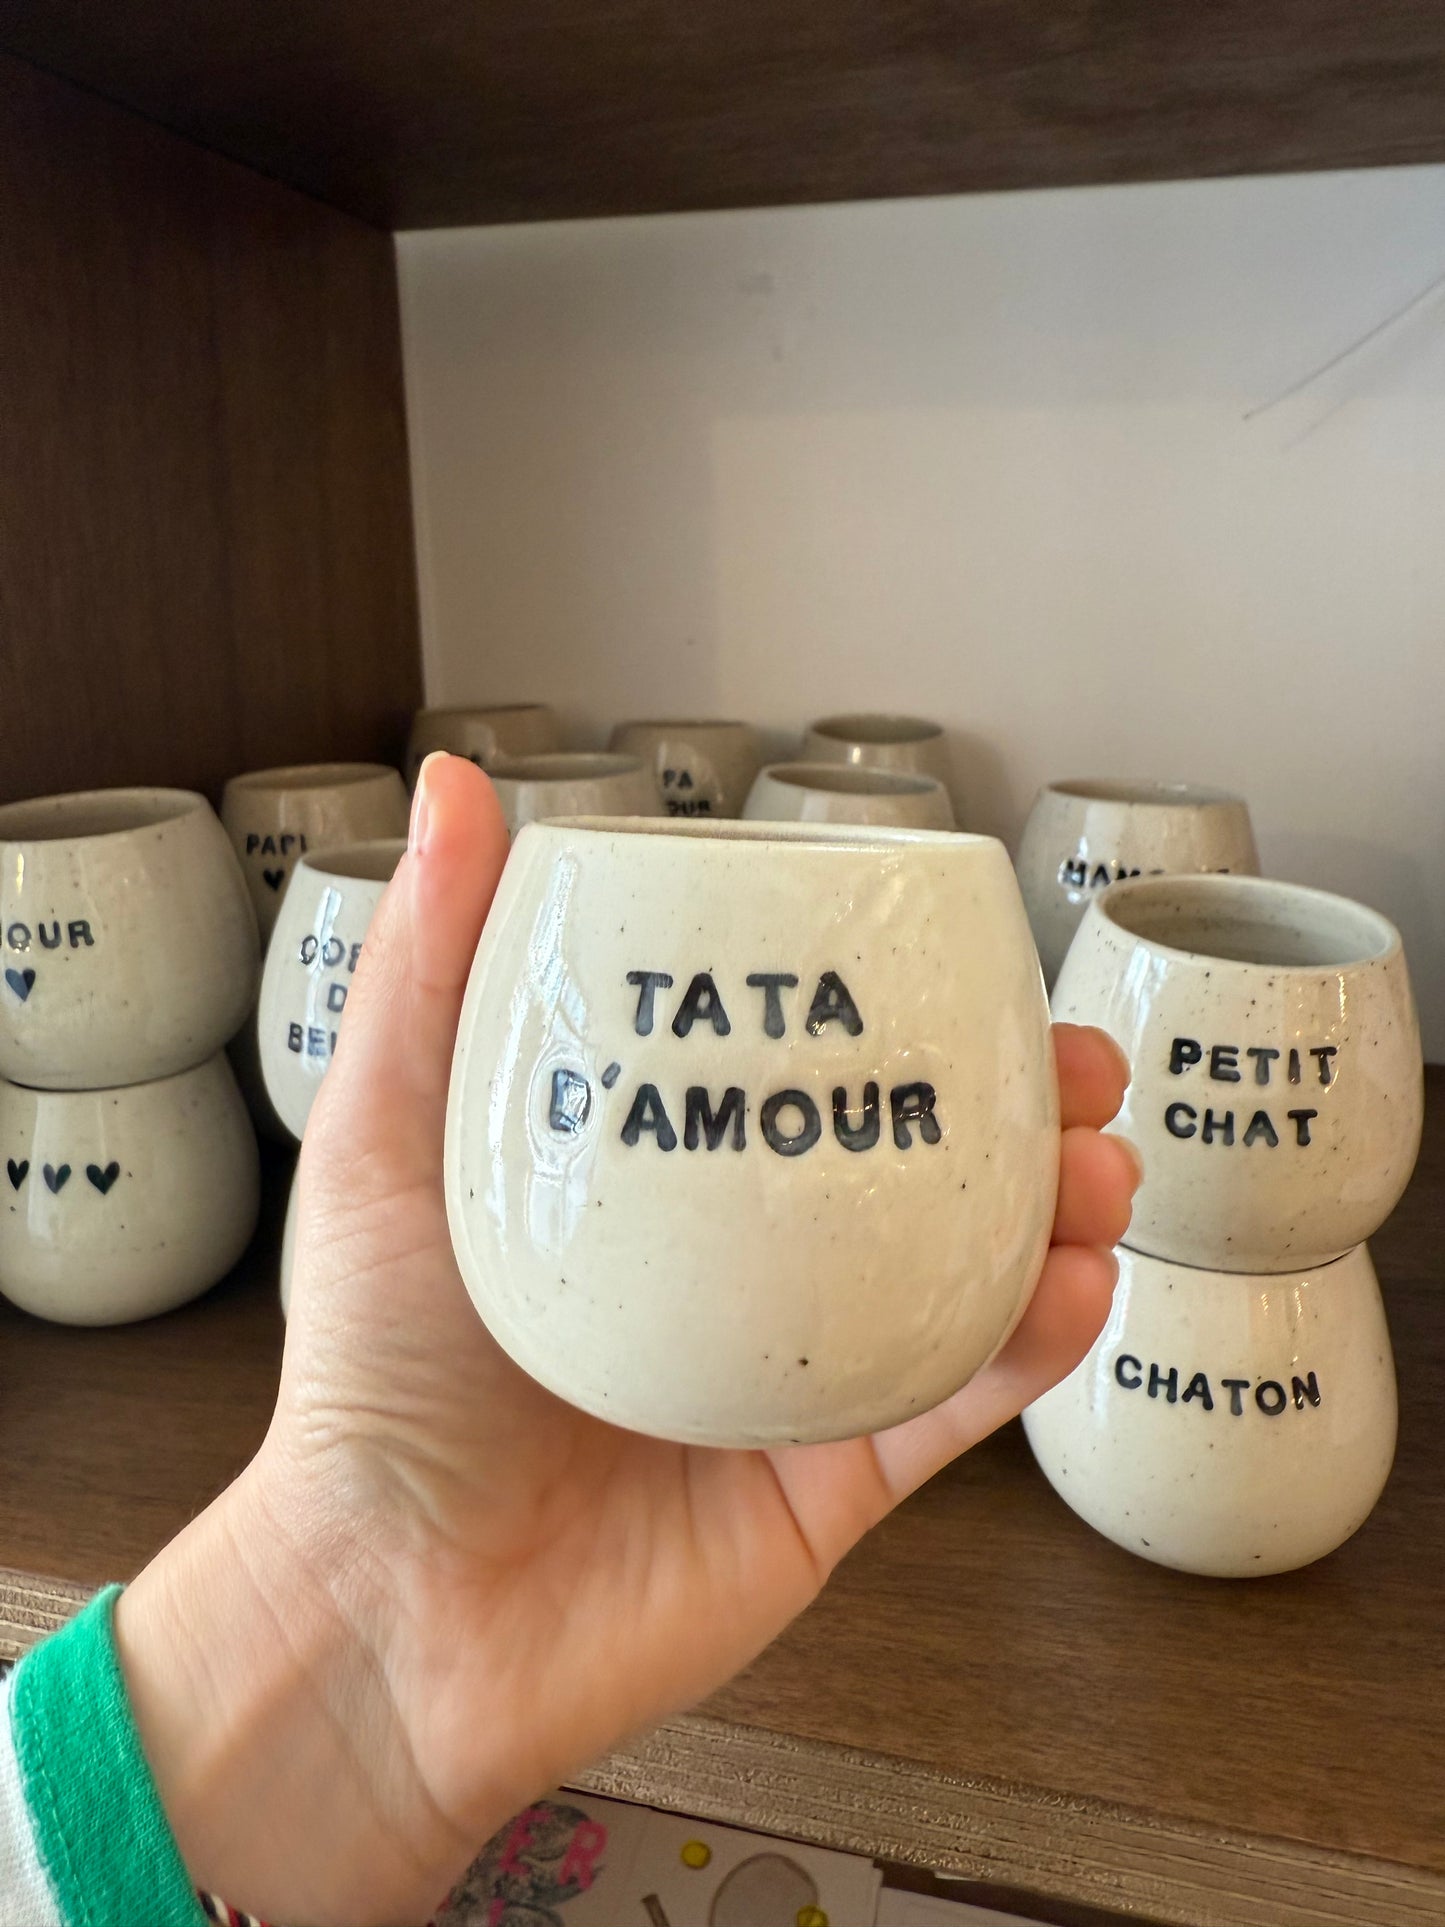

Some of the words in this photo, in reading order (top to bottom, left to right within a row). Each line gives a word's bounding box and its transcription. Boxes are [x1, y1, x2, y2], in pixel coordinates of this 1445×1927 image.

[0, 920, 95, 953] OUR
[626, 971, 864, 1040] TATA
[1168, 1036, 1338, 1086] PETIT
[549, 1062, 942, 1157] D'AMOUR
[1164, 1101, 1318, 1148] CHAT
[1114, 1353, 1322, 1417] CHATON
